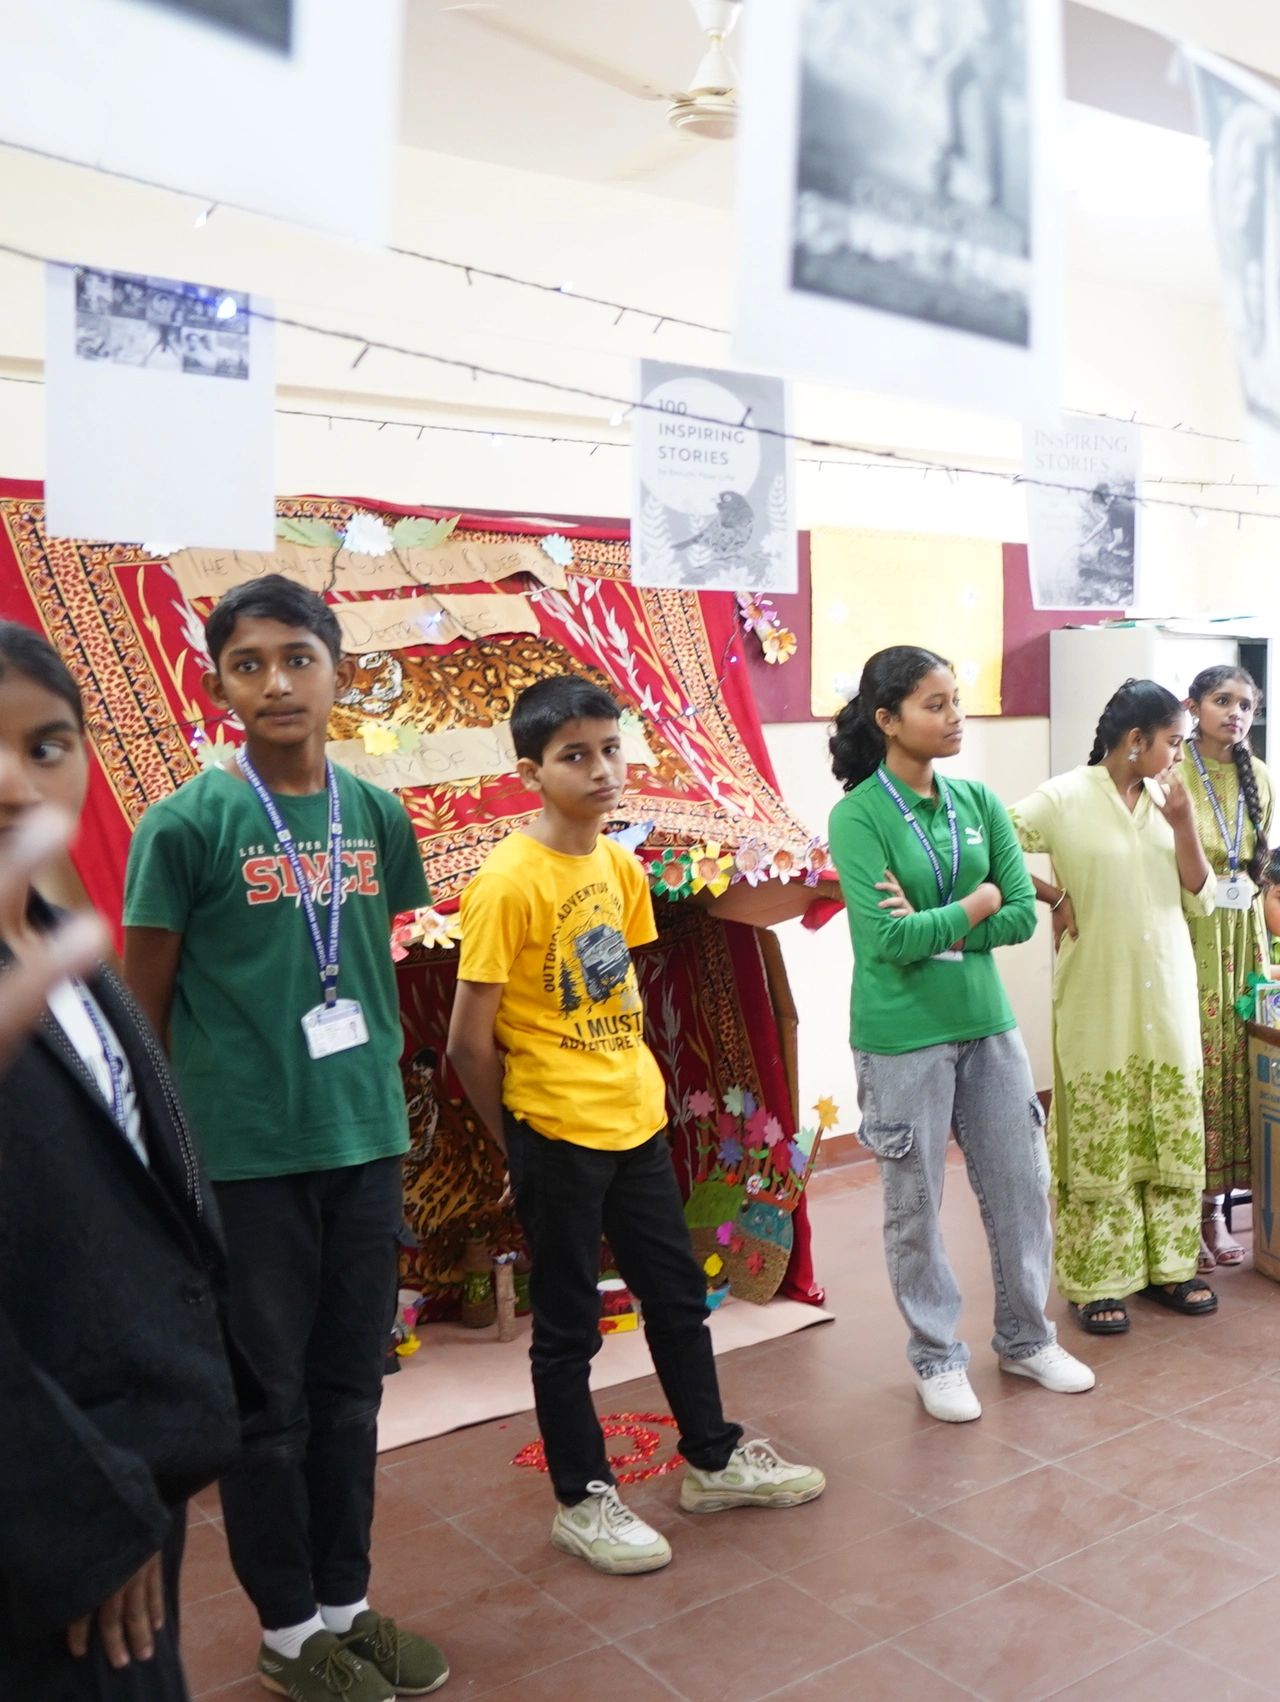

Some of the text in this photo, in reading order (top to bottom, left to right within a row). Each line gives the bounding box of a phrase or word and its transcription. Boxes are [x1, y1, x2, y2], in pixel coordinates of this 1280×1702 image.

[660, 399, 688, 416] 100
[658, 424, 745, 445] INSPIRING
[1033, 429, 1128, 453] INSPIRING
[658, 445, 729, 466] STORIES
[1034, 453, 1110, 473] STORIES
[264, 801, 284, 832] SCHOOL
[239, 844, 265, 858] LEE
[273, 839, 322, 854] CPER
[241, 850, 380, 906] SINCE
[283, 841, 327, 970] LITTLE ANGELS MODERN HIGH SCHOOL
[331, 880, 341, 911] MODERN
[330, 910, 340, 938] ANGELS
[327, 938, 339, 963] LITTLE
[574, 1011, 641, 1039] I MUST
